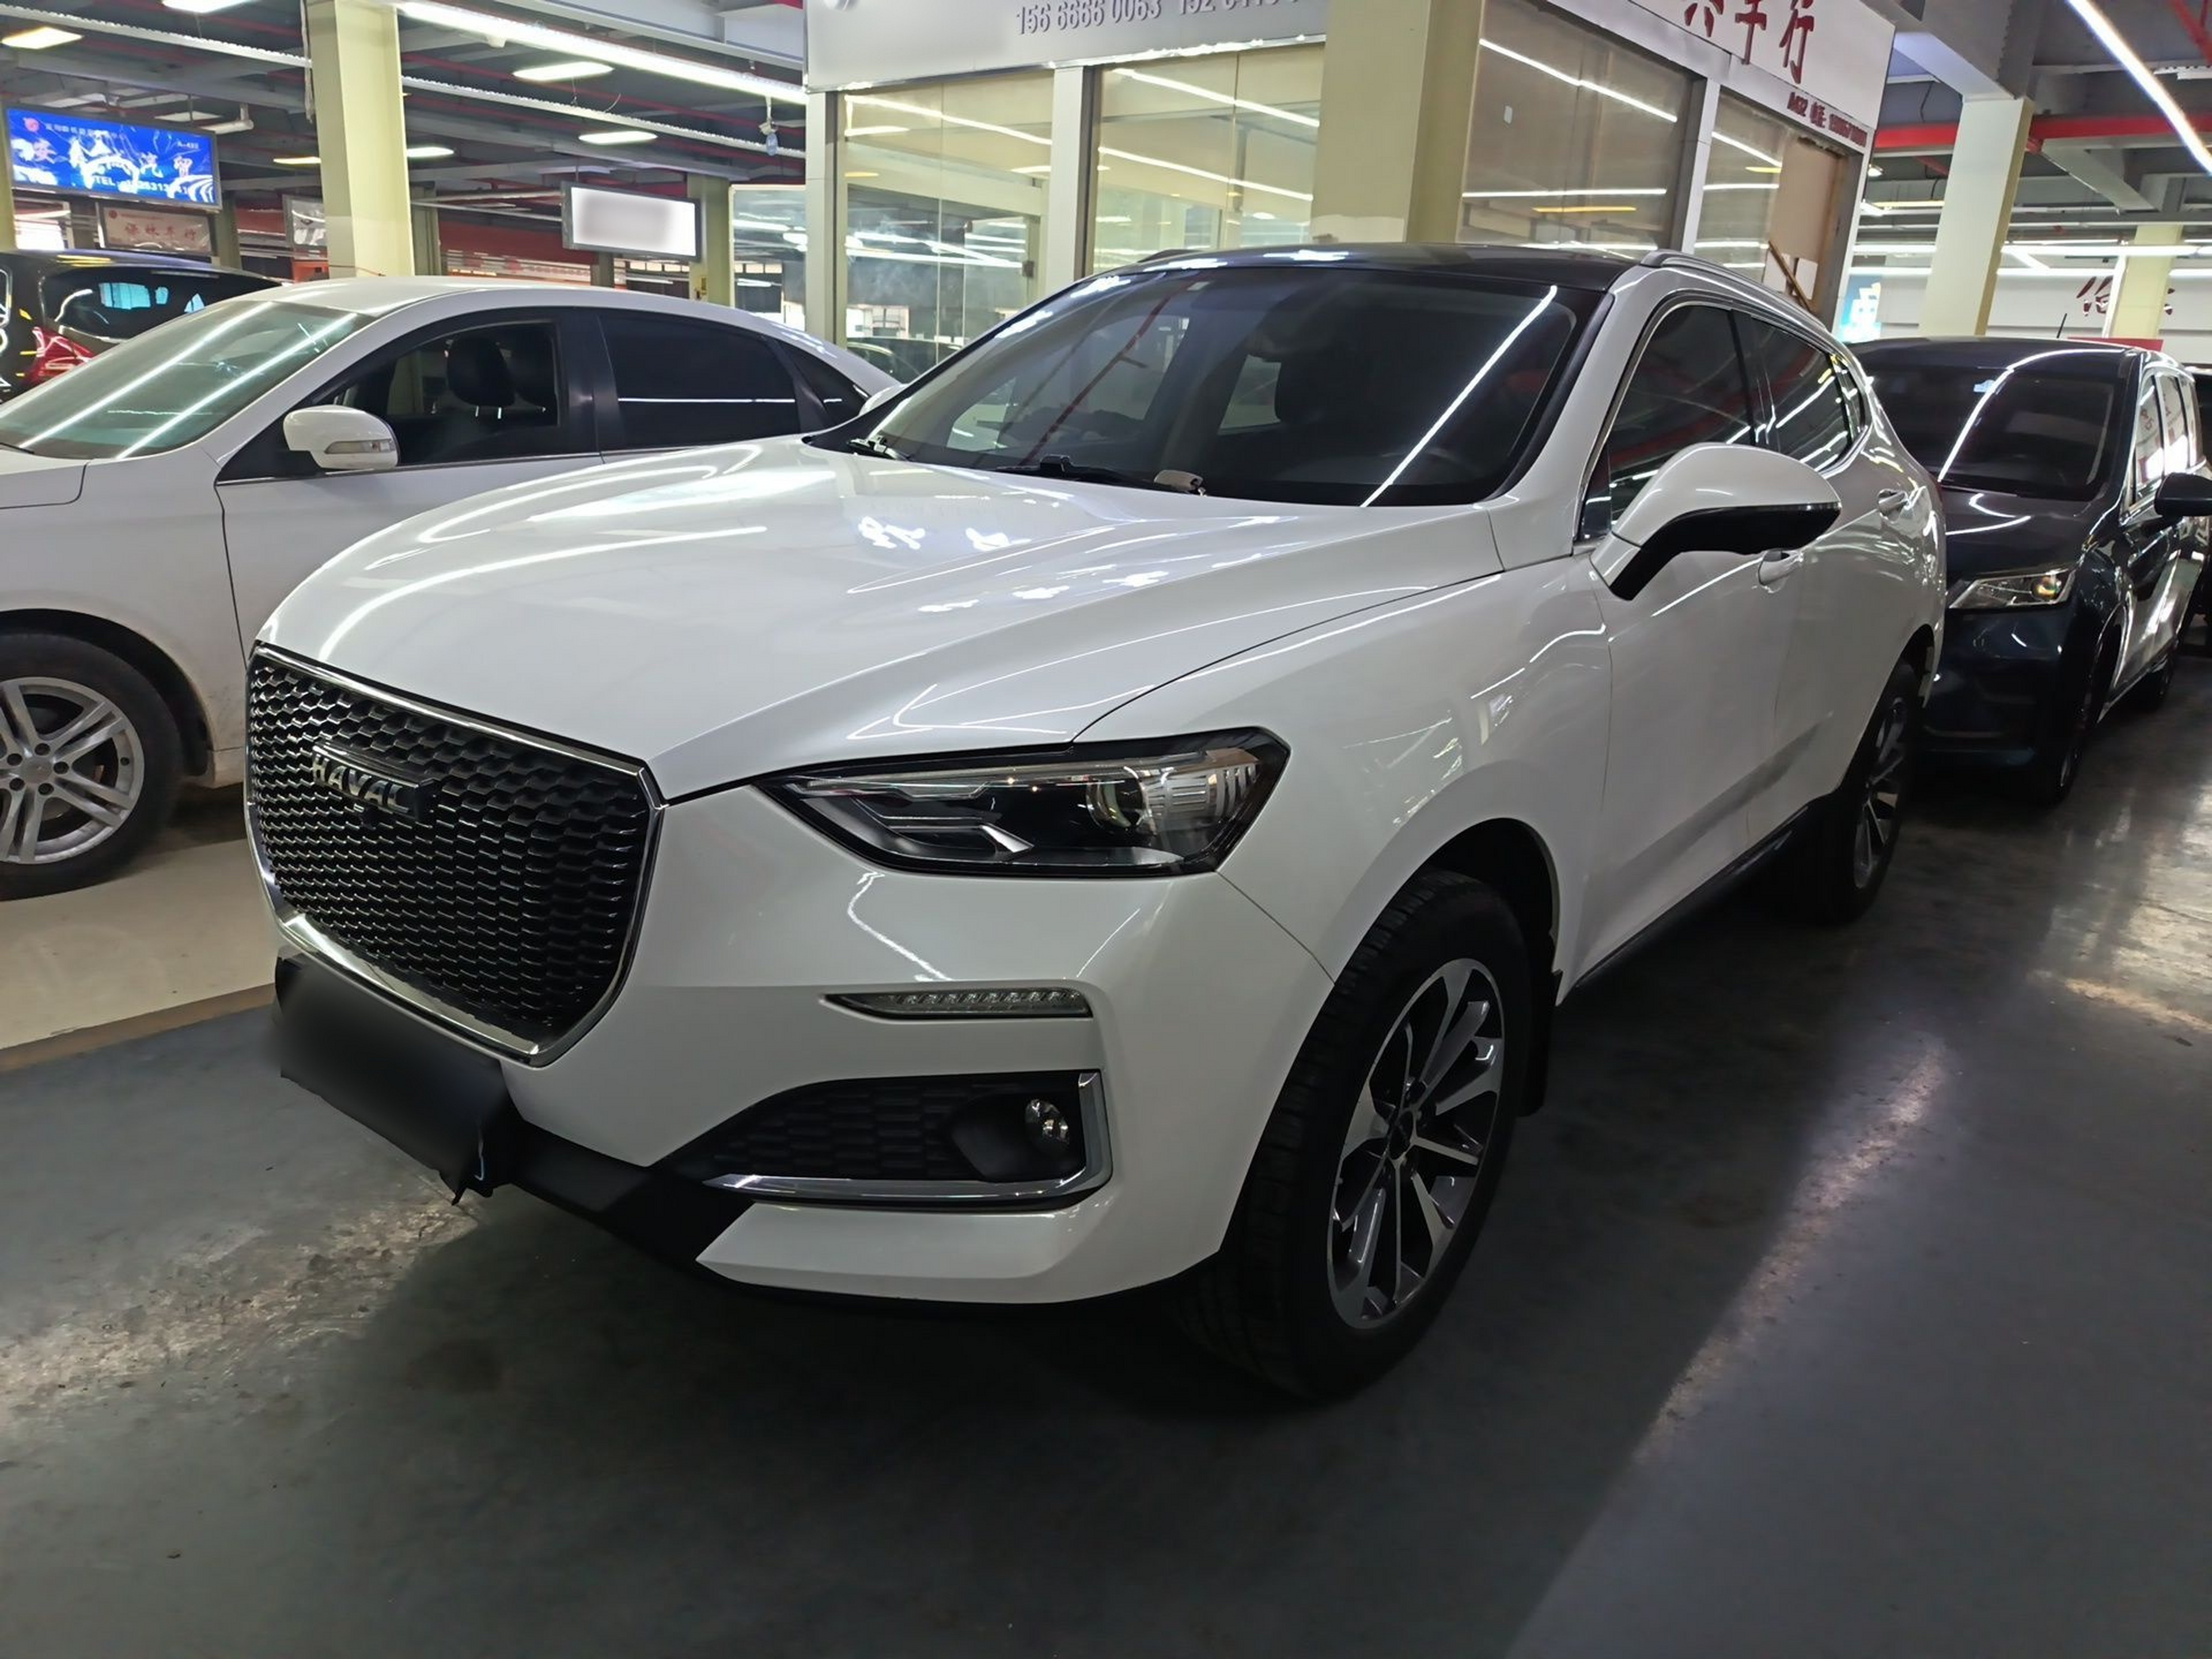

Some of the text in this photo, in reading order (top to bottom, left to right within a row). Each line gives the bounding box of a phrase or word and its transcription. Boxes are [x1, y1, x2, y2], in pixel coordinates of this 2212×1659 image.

[1016, 3, 1051, 34] 156
[1058, 0, 1105, 31] 6666
[312, 752, 410, 814] HAVAL
